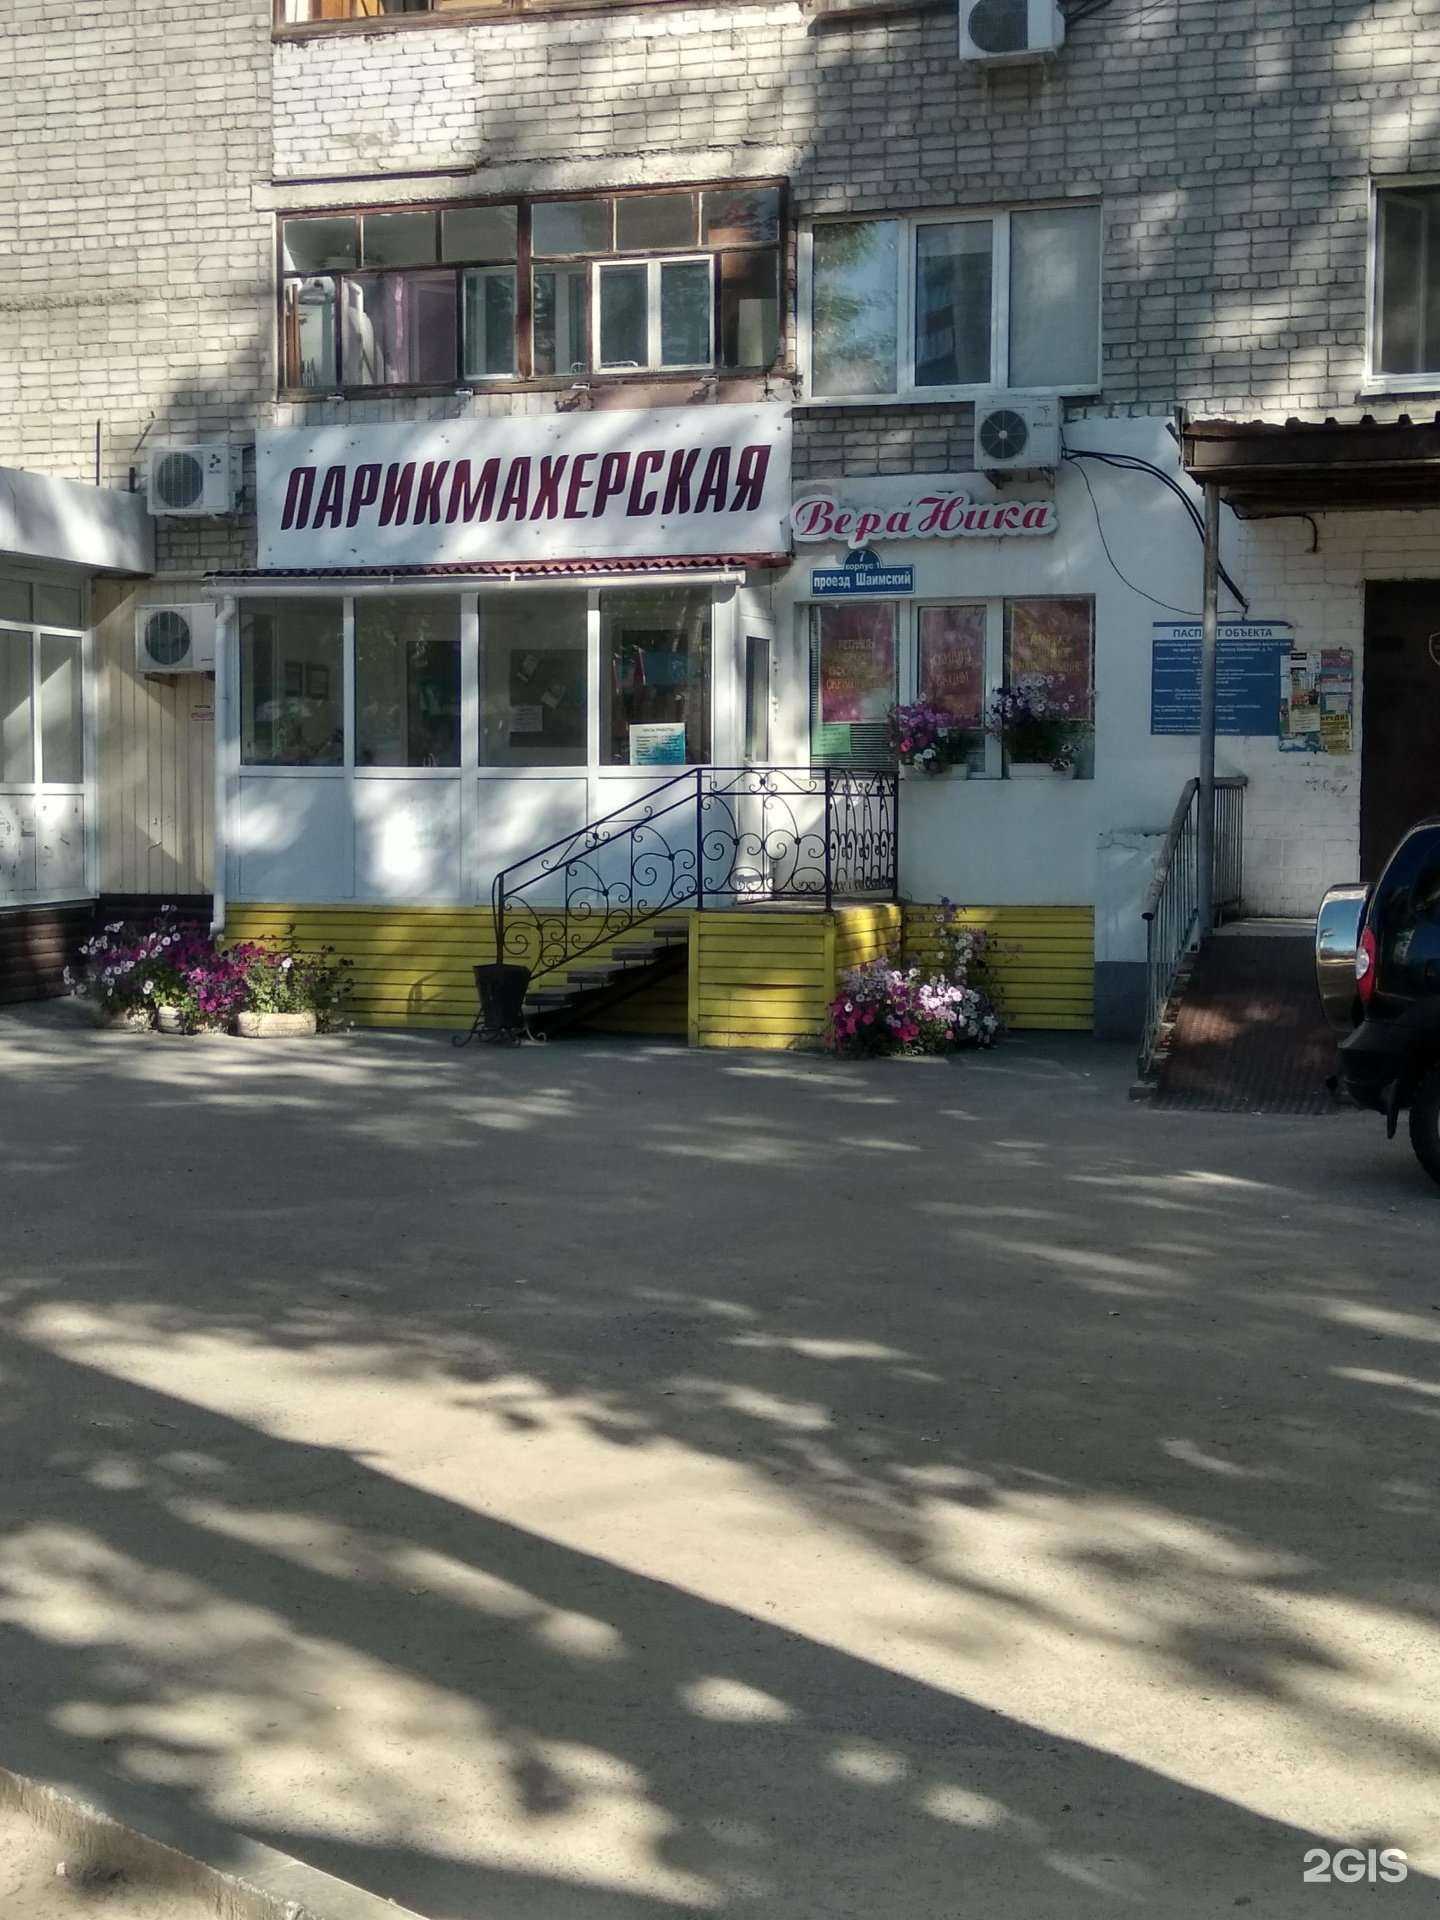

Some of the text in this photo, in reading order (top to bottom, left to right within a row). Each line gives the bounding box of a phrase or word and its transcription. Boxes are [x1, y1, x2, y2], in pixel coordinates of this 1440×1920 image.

[281, 444, 772, 531] ПАРИКМАХЕРСКАЯ
[795, 496, 1049, 542] Вера Ника
[859, 550, 865, 562] 7
[845, 562, 874, 571] корпус
[813, 571, 911, 590] проезд Шаимский
[1173, 628, 1273, 638] ПАСПТ ОБЪЕКТА
